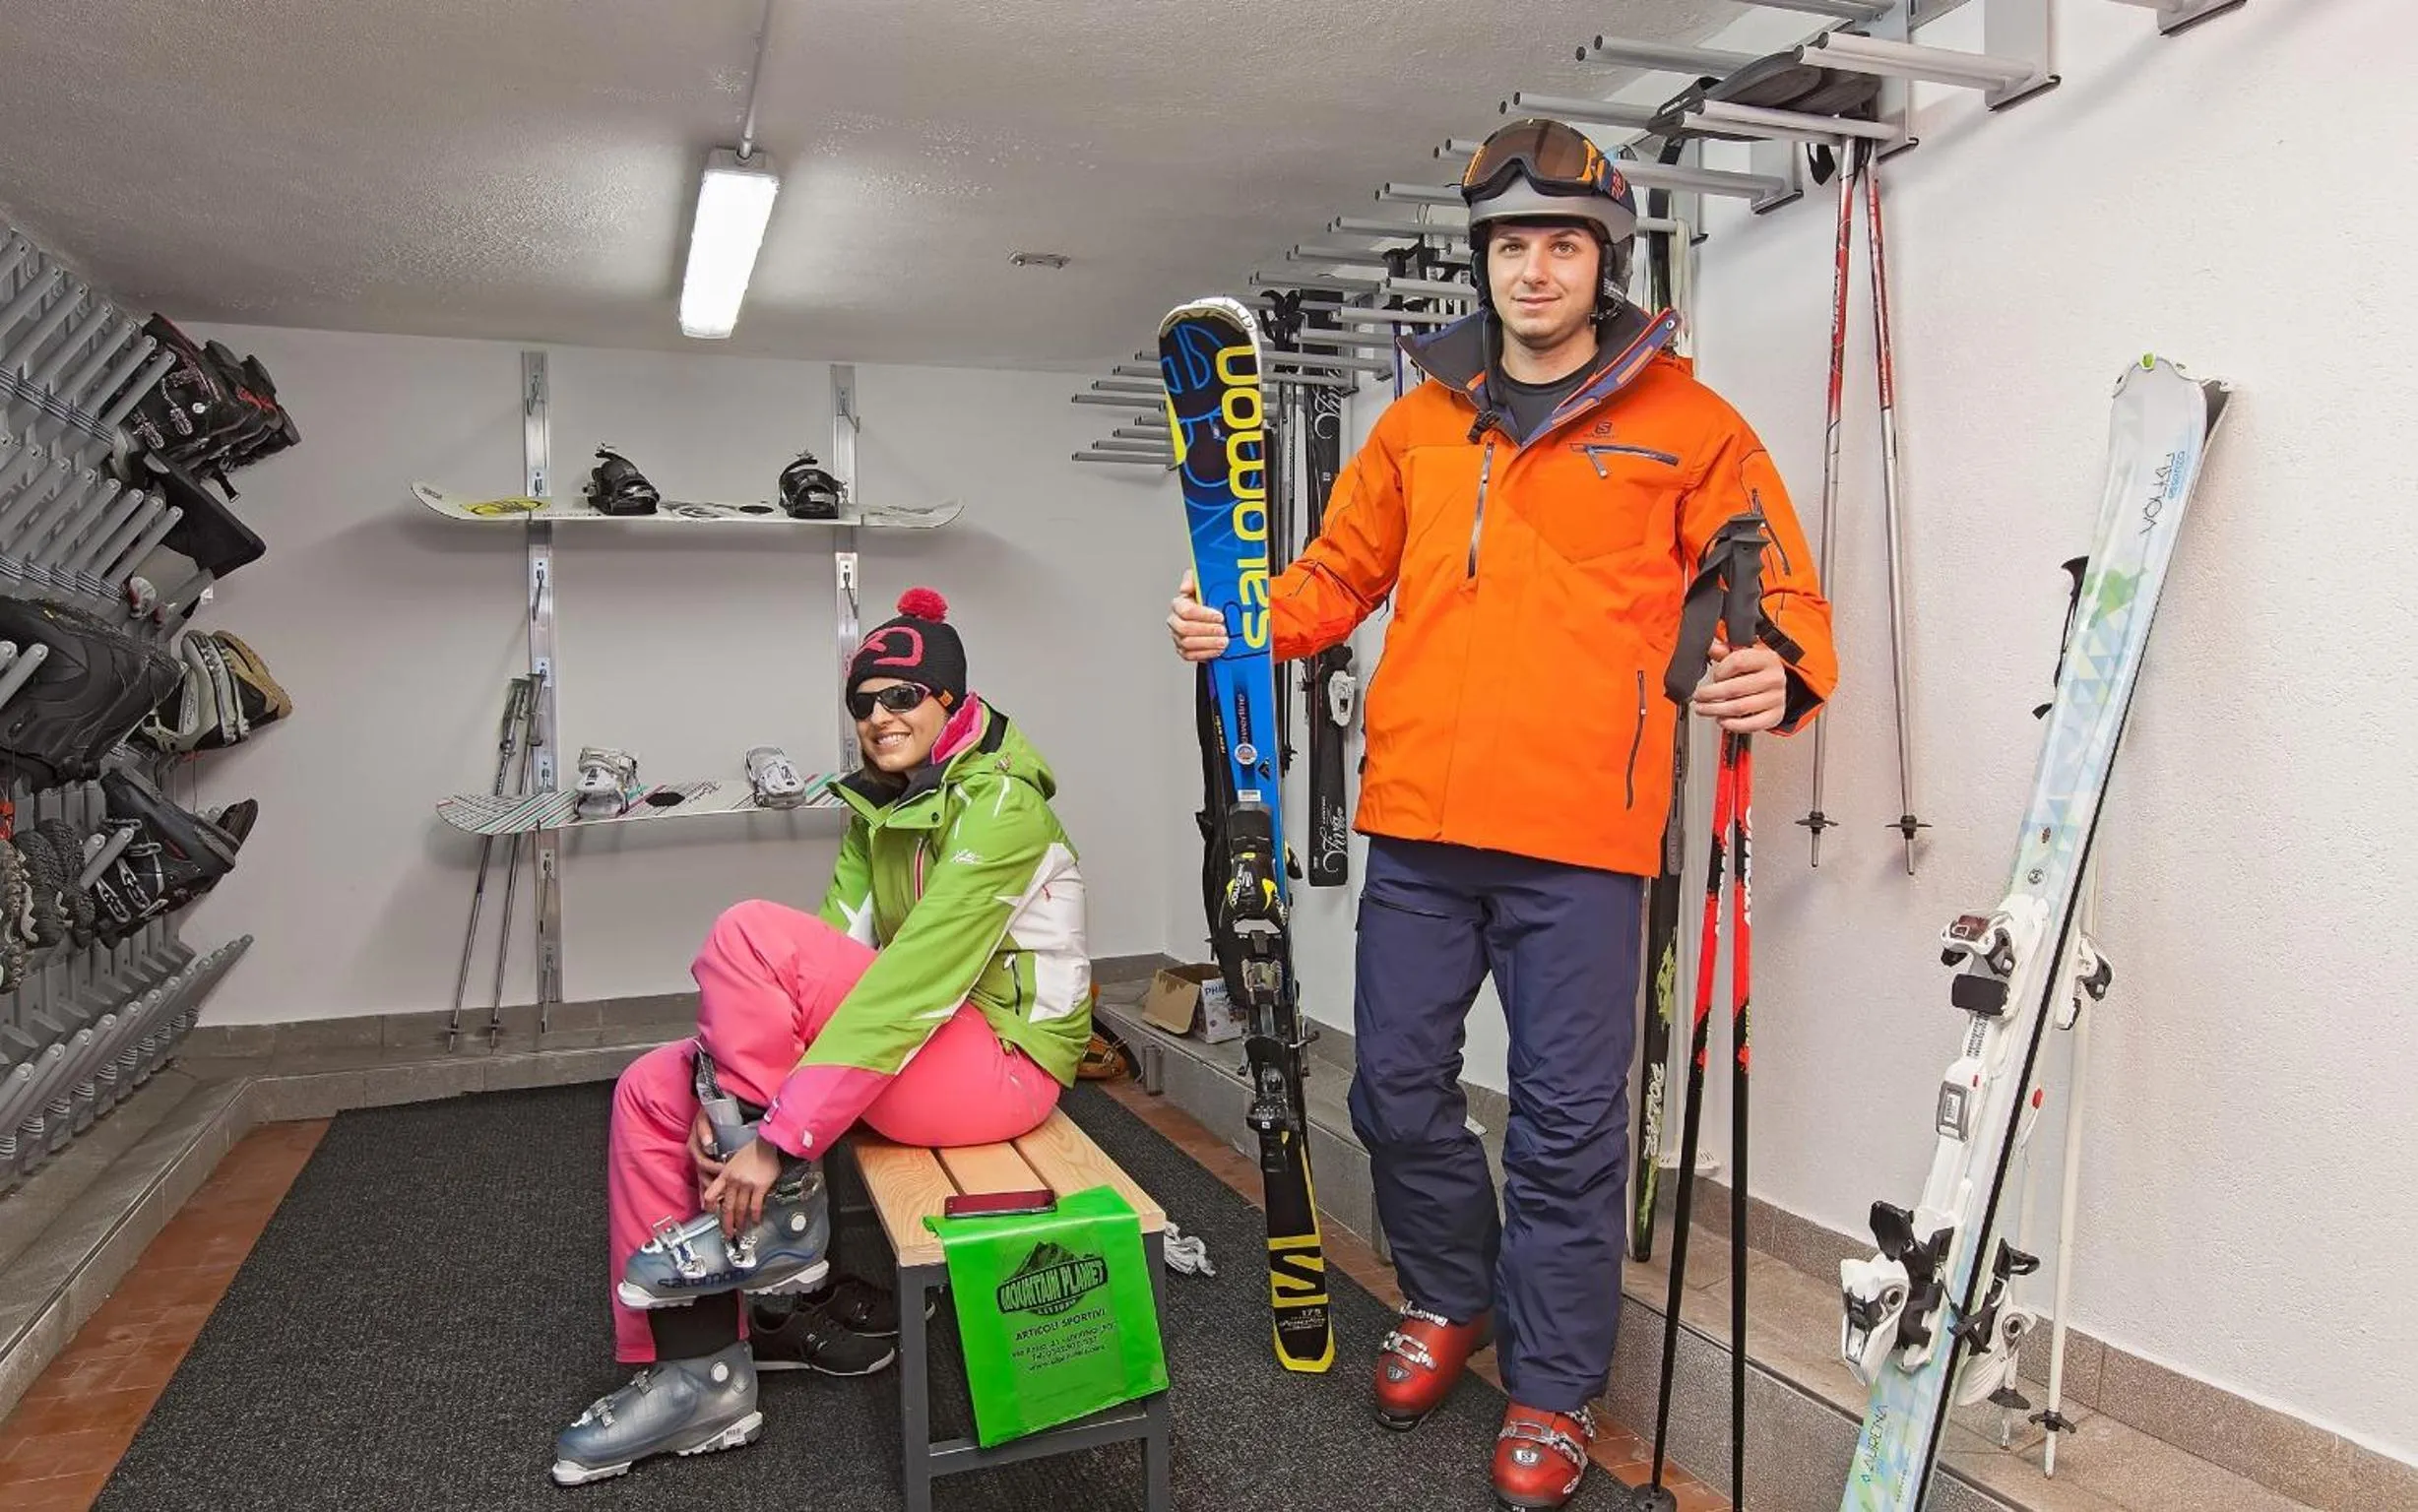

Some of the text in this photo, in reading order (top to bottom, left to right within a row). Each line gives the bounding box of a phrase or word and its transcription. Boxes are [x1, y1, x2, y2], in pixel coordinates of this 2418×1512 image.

[1216, 346, 1270, 648] salomon
[1238, 693, 1248, 745] owerline
[1205, 984, 1229, 996] PHIL
[1000, 1260, 1105, 1310] MOUNTAIN PLANET
[1016, 1321, 1059, 1341] ARTICOLI
[1061, 1308, 1106, 1328] SPORTIVI
